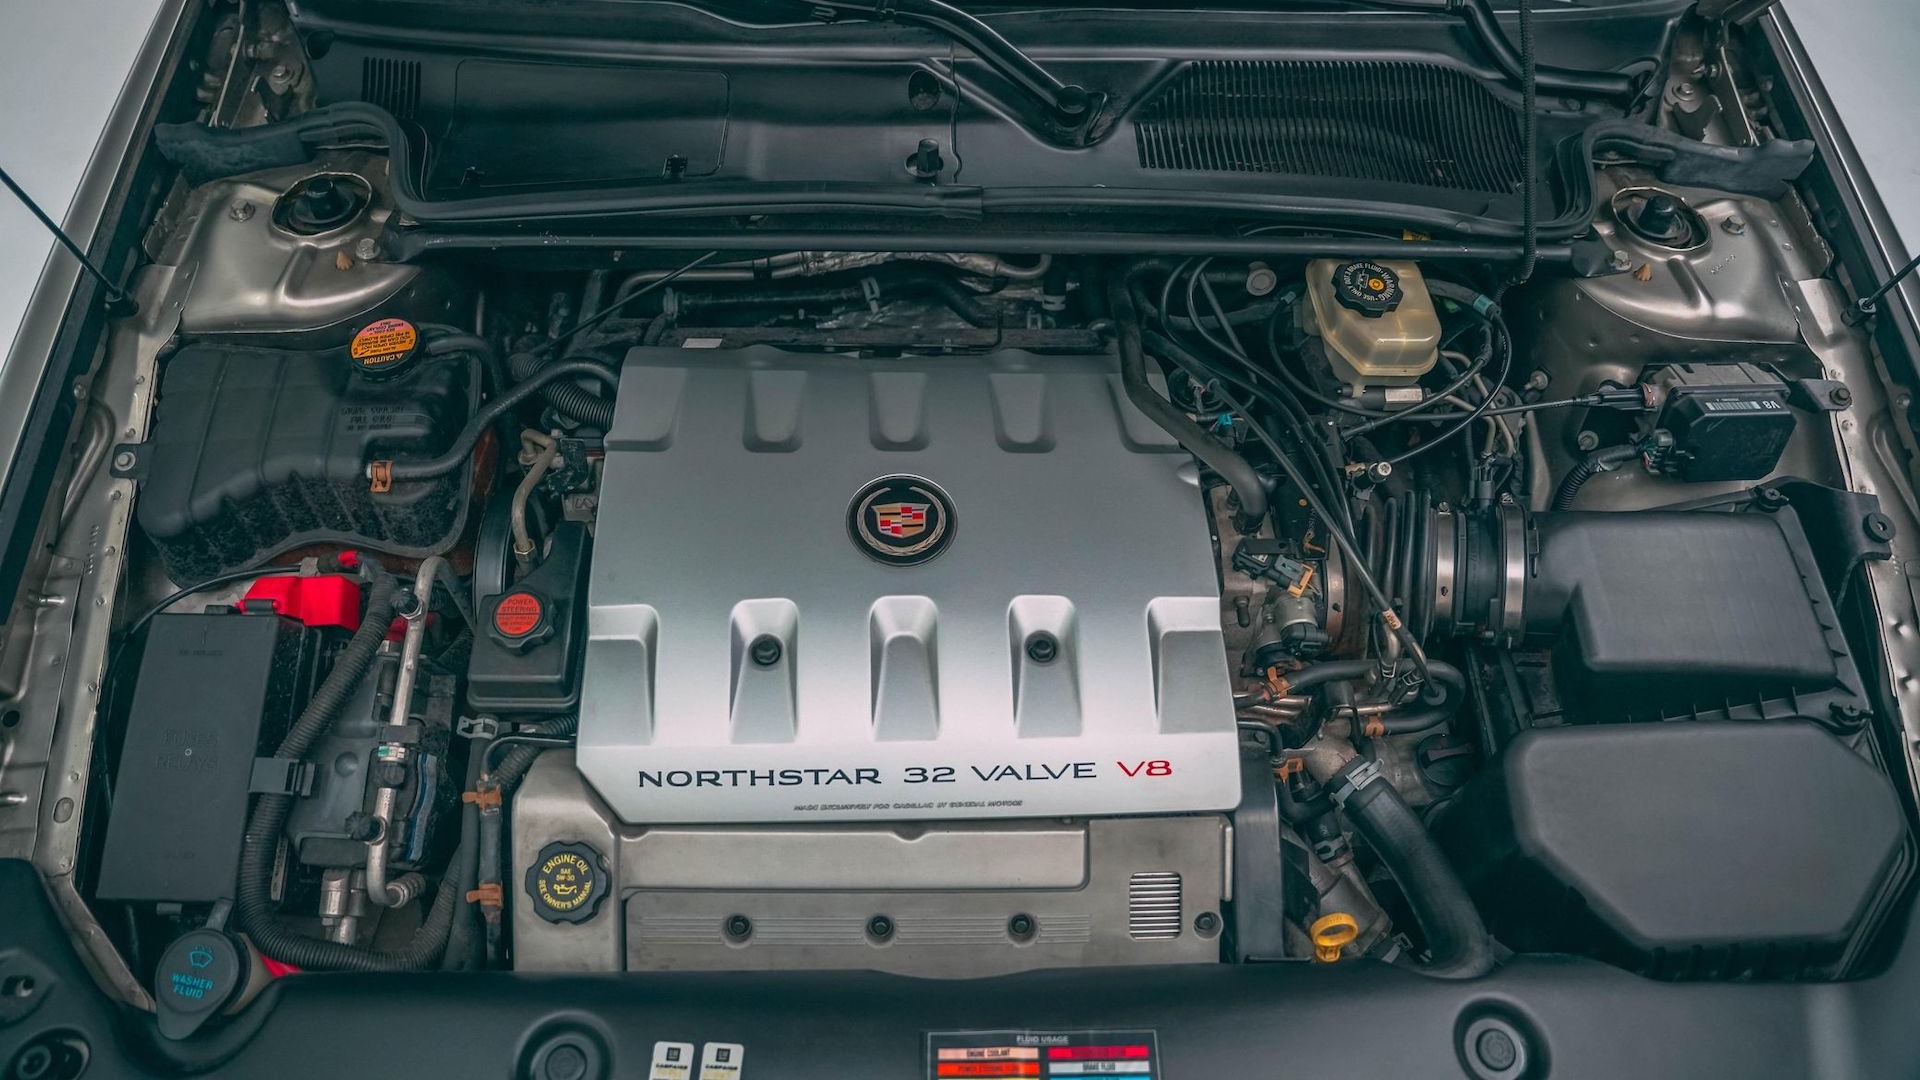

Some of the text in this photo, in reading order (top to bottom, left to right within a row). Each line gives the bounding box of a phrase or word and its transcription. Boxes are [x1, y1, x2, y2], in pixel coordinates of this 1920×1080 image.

[1347, 263, 1365, 273] BRAKE
[1365, 263, 1382, 273] FLUID
[1378, 272, 1395, 301] WARNING
[363, 353, 396, 365] CAUTION
[1763, 400, 1781, 409] V8
[154, 754, 219, 769] RELAYS
[639, 760, 1174, 787] NORTHSTAR 32 VALVE V8
[543, 854, 590, 876] ENGINE OIL
[538, 879, 592, 909] SEE OWNER'S MANUAL
[171, 973, 215, 990] WASHER
[173, 984, 205, 999] FLUID
[1016, 1035, 1069, 1043] FLUID USAGE
